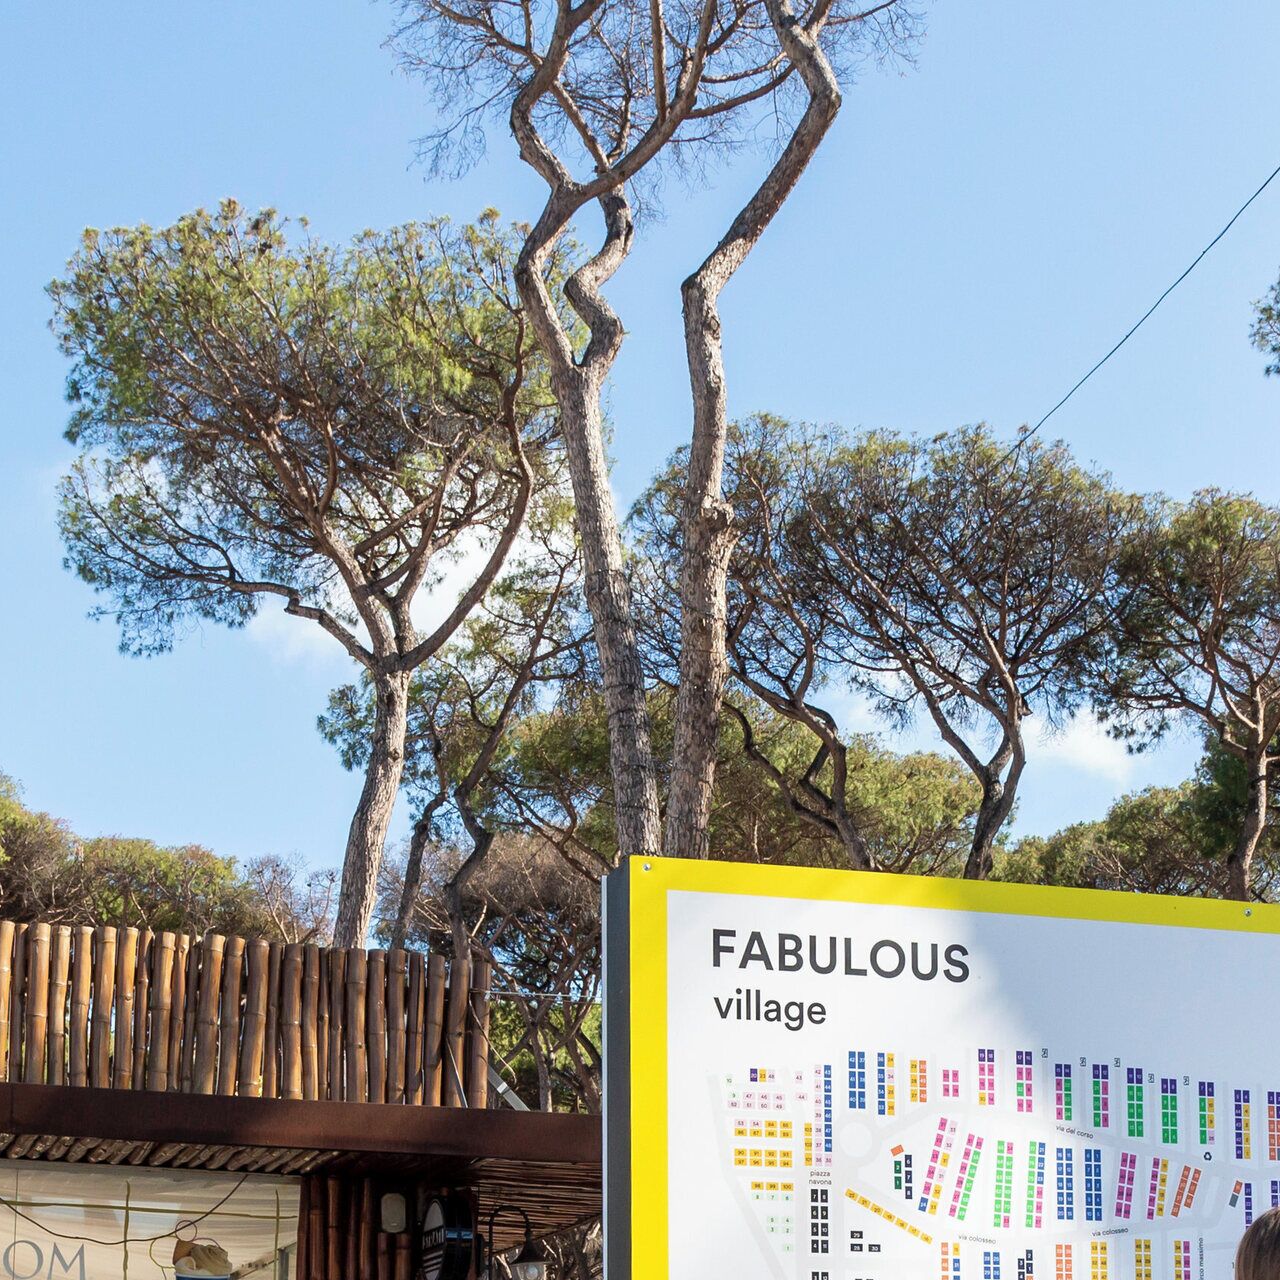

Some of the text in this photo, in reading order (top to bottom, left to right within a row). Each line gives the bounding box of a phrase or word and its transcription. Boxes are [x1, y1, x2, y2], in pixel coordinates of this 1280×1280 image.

[711, 928, 970, 983] FABULOUS
[714, 988, 827, 1031] village
[1056, 1125, 1065, 1133] via
[1076, 1130, 1094, 1139] corso
[810, 1170, 831, 1178] piazza
[969, 1235, 996, 1244] colosseo
